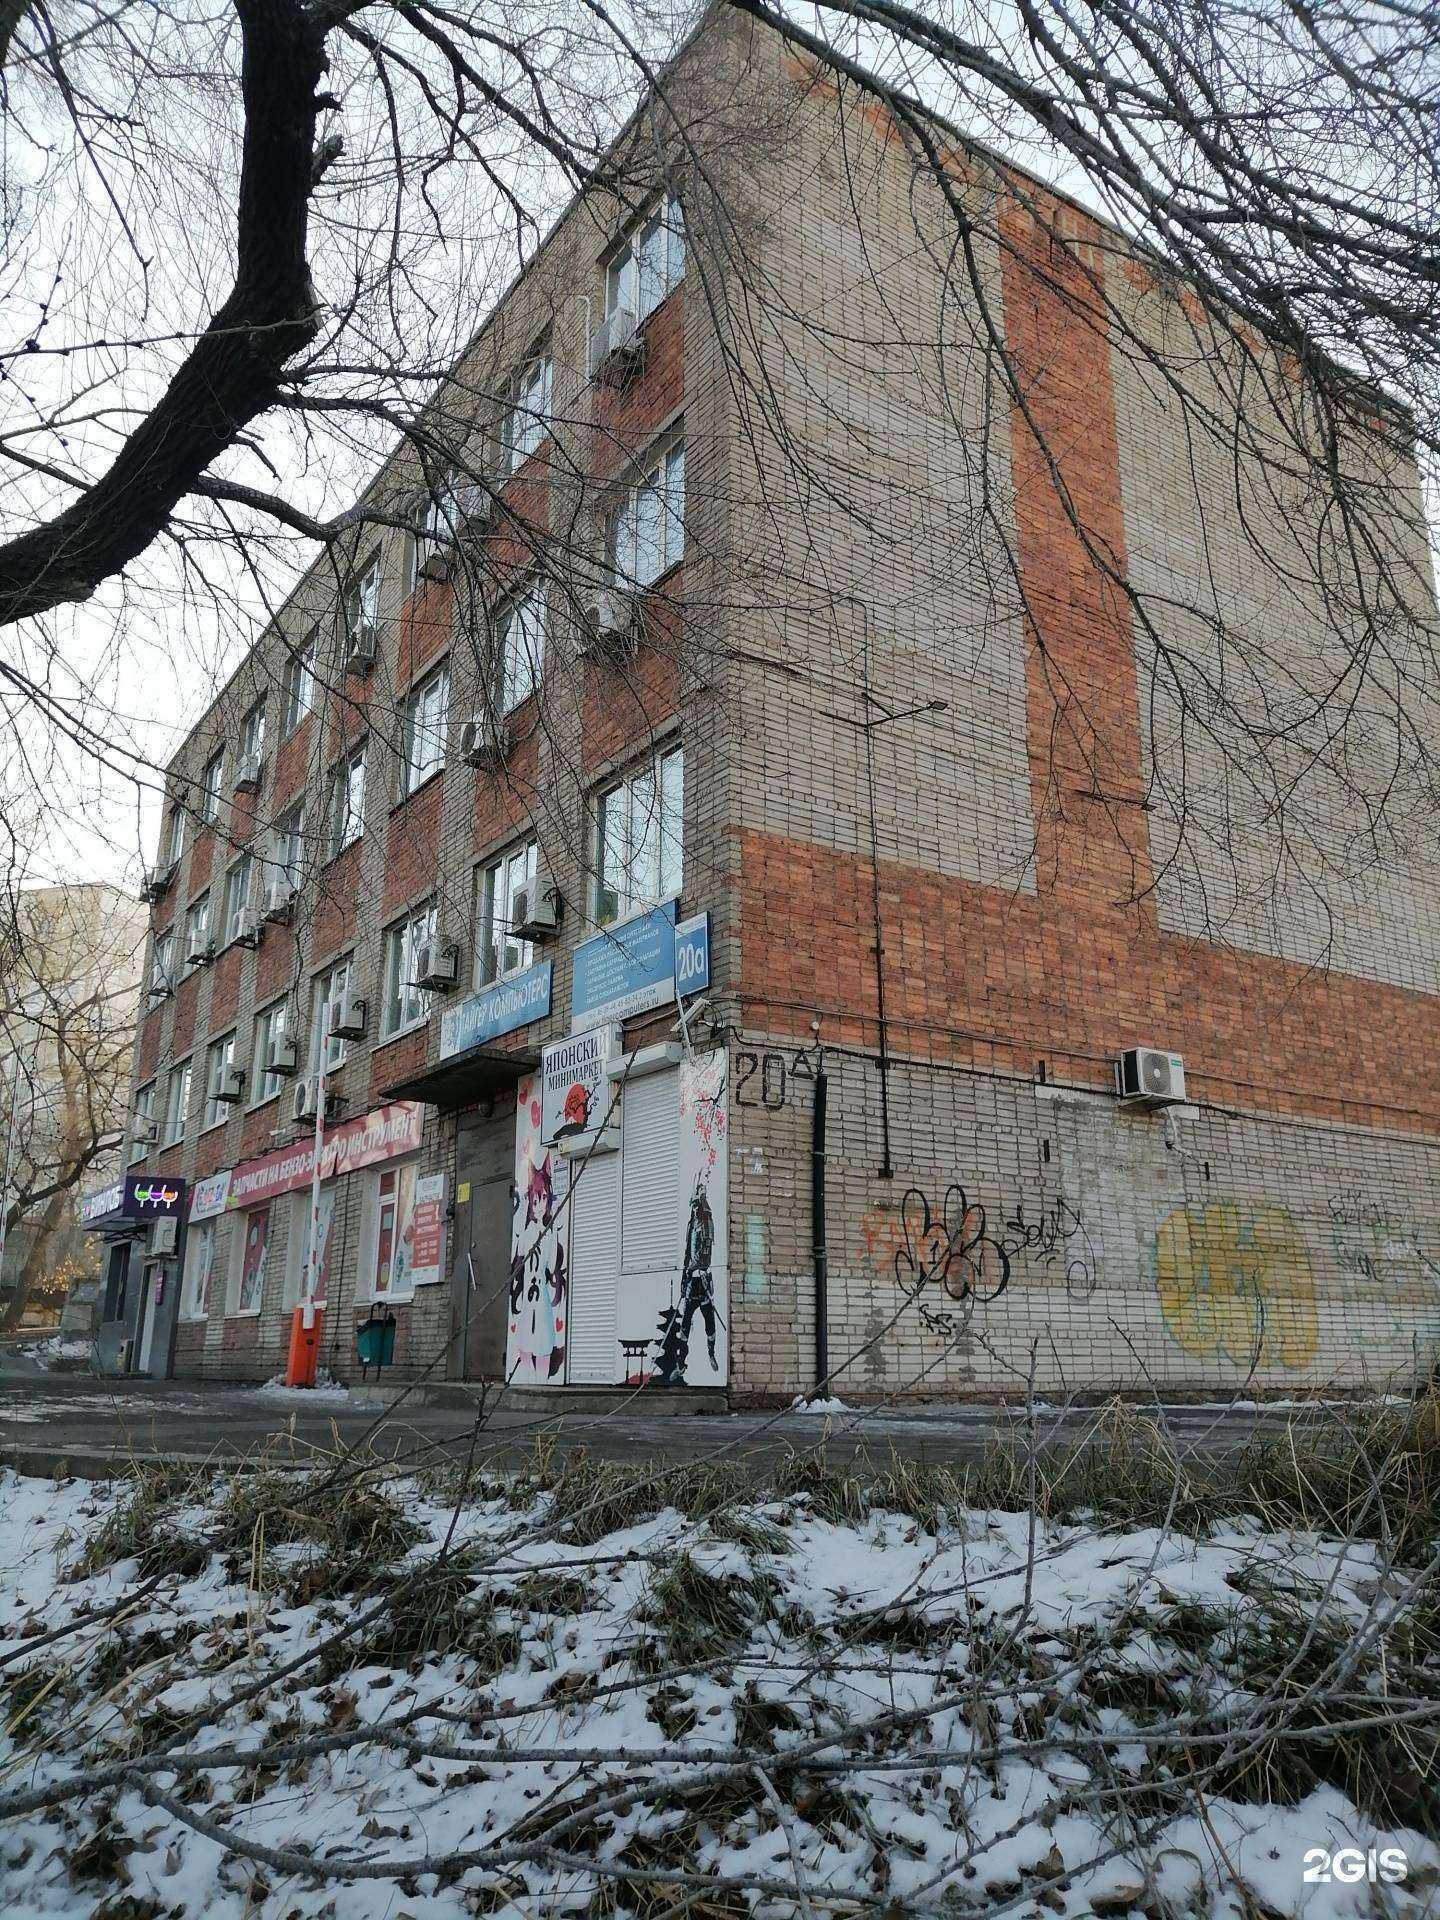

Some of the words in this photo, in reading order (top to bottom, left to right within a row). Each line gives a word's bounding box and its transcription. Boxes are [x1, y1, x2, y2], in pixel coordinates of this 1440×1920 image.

[679, 943, 704, 981] 20а
[489, 974, 548, 1022] КОМПЬЮТЕРС
[545, 1027, 607, 1074] ЯПОНСКИЙ
[548, 1060, 602, 1091] МИНИМАРКЕТ
[347, 1112, 417, 1156] ИНСТРУМЕНТ
